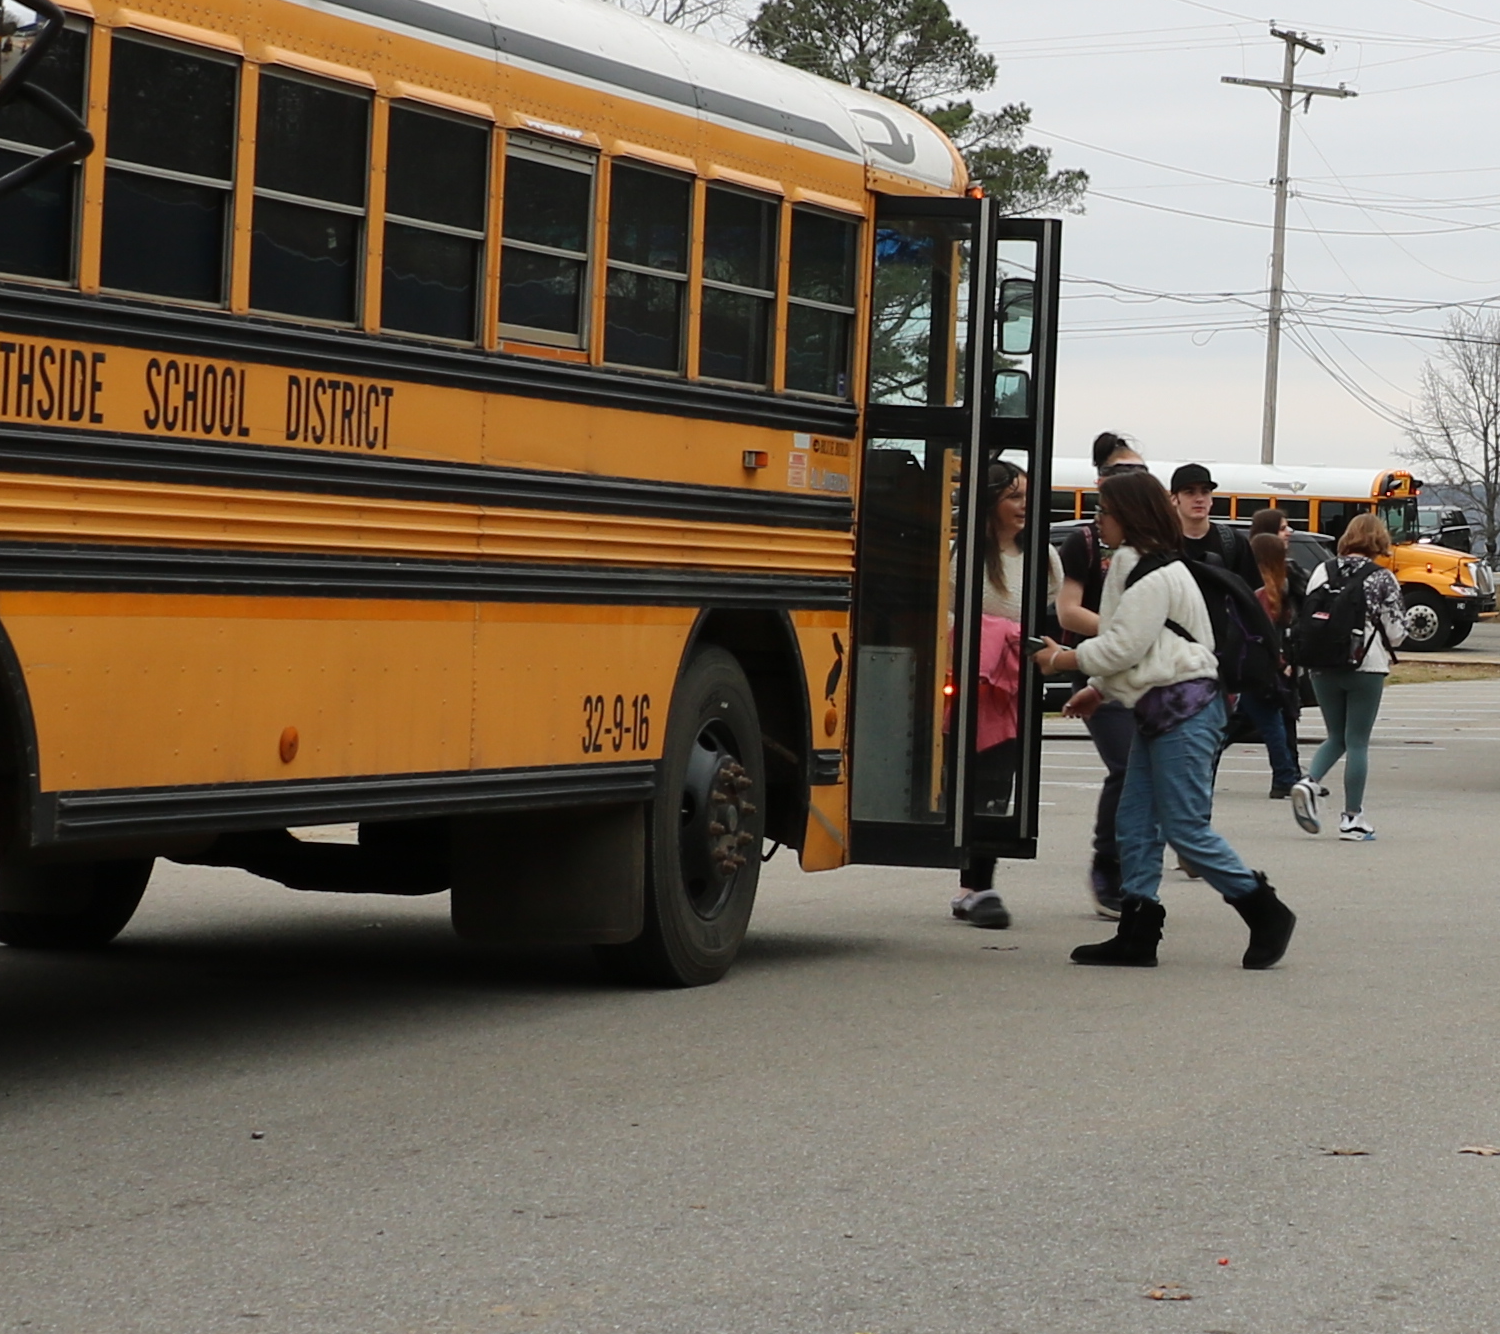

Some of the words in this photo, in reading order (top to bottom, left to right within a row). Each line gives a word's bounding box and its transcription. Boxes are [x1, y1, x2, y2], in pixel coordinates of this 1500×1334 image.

[143, 357, 250, 437] SCHOOL
[285, 374, 394, 450] DISTRICT
[582, 693, 651, 754] 32-9-16
